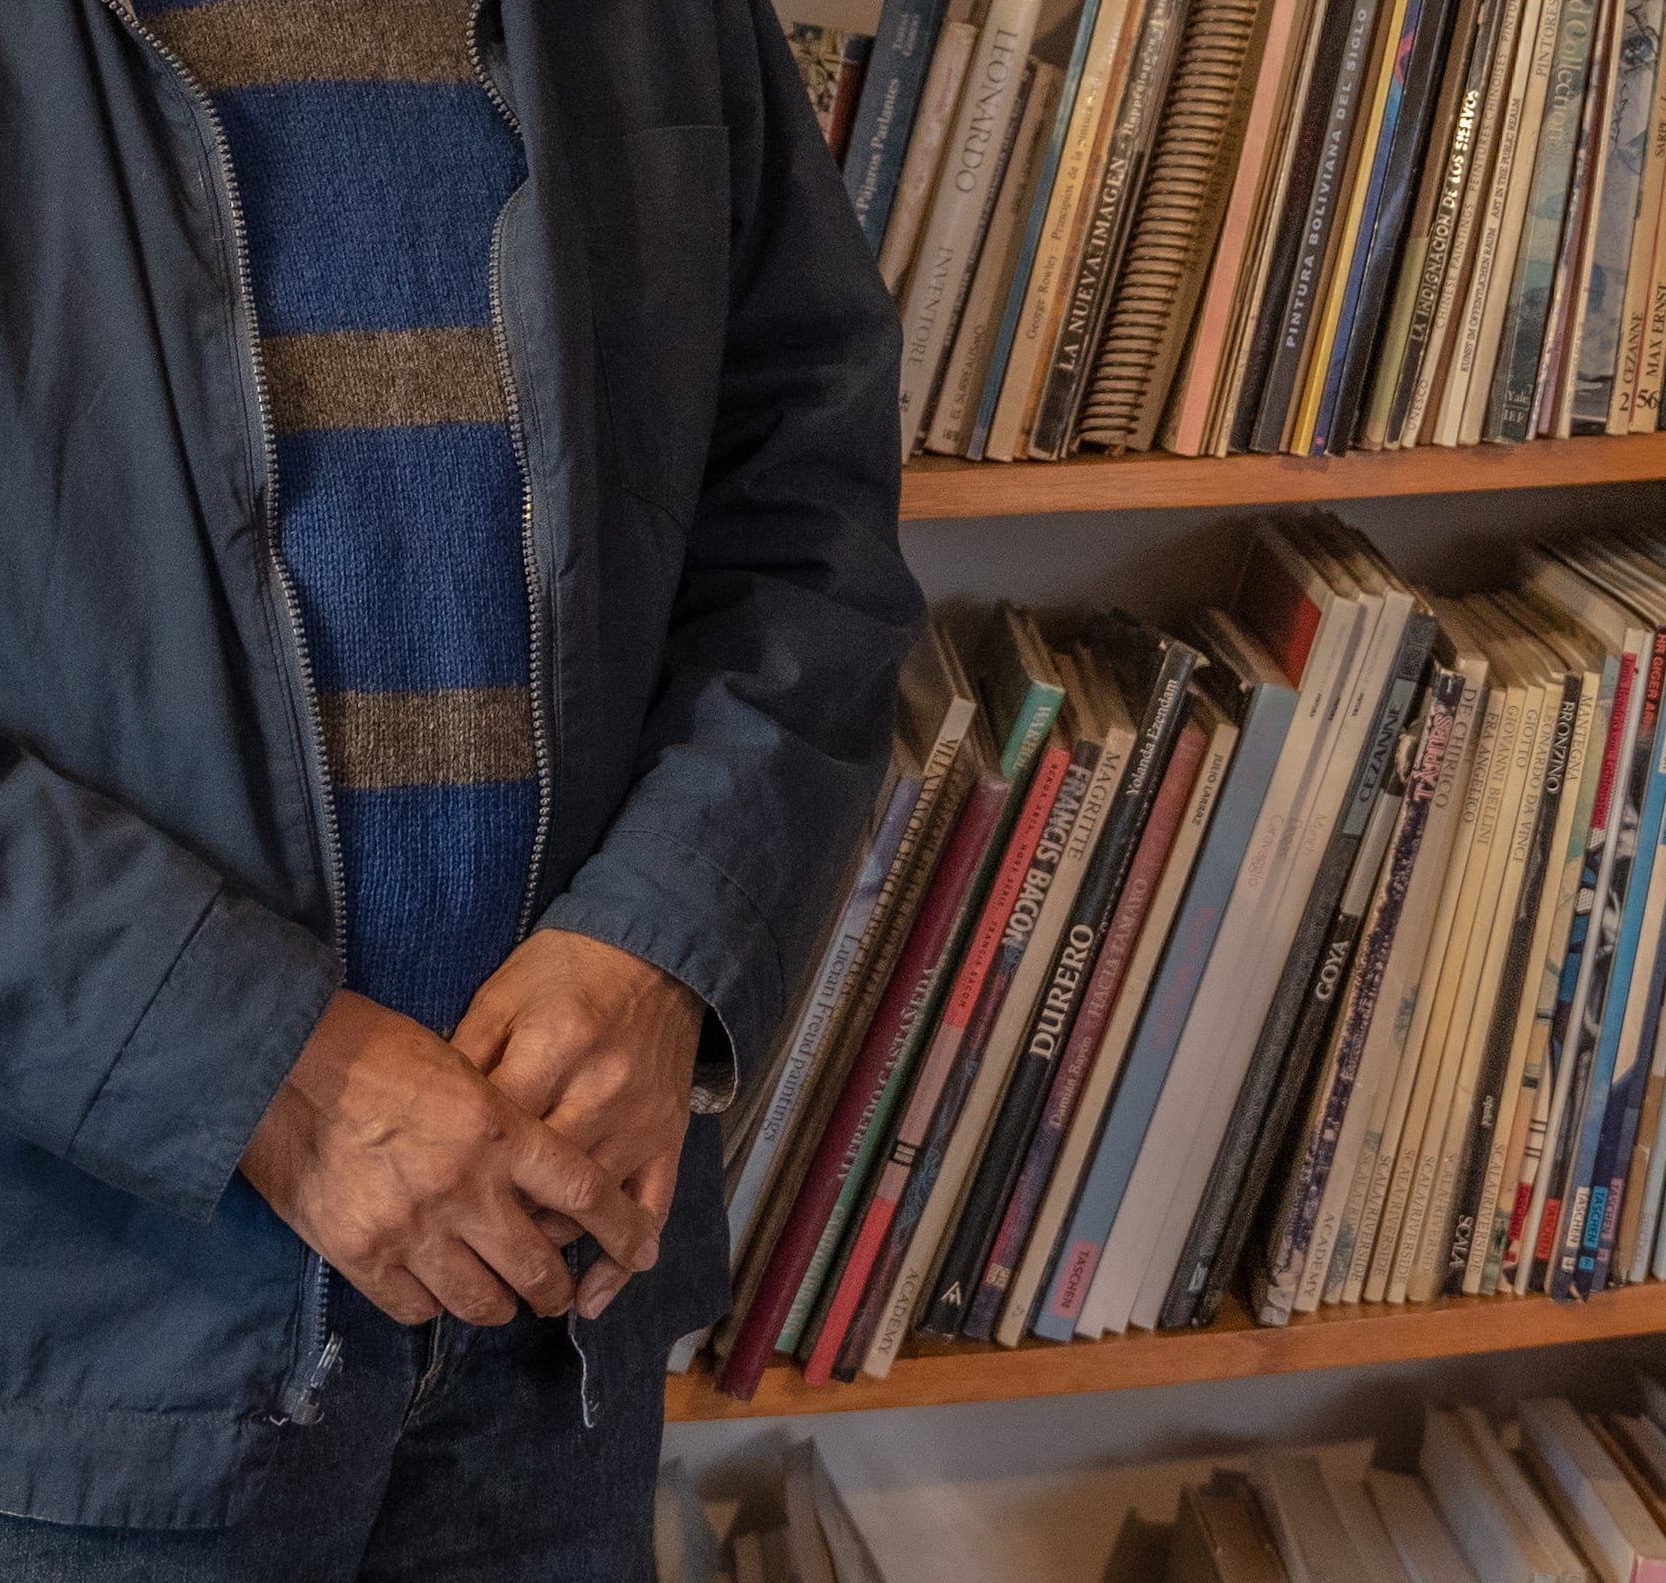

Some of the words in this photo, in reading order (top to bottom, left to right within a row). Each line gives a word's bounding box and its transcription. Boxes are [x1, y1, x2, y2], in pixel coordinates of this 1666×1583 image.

[952, 27, 1019, 194] LEONARDO
[1544, 17, 1589, 143] Collection
[1284, 253, 1316, 348] PINTURA
[1305, 129, 1344, 245] BOLIVIANA
[1334, 81, 1352, 118] DEL
[1344, 7, 1368, 71] SIGLO
[1615, 310, 1649, 384] CEZANNE
[1644, 338, 1664, 377] MAX
[1619, 391, 1631, 412] 2
[1456, 685, 1478, 715] DE
[1512, 707, 1540, 768] GIOTTO
[1563, 694, 1595, 782] MANTEGNA
[1205, 753, 1224, 783] JULIO
[1354, 701, 1406, 803] CEZANNE
[1432, 718, 1470, 808] CHIRICO
[1490, 703, 1519, 782] GIOVANNI
[1541, 699, 1577, 794] BRONZINO
[1030, 761, 1097, 864] FRANCIS
[1063, 749, 1124, 860] MAGRITTE
[1190, 784, 1213, 825] LARRAZ
[1476, 785, 1500, 844] BELLINI
[998, 865, 1053, 949] BACON
[818, 932, 861, 1000] Lucian
[1024, 922, 1100, 1061] DURERO
[1312, 937, 1351, 1002] GOYA
[796, 999, 834, 1056] Freud
[758, 1054, 811, 1142] paintings
[1060, 1247, 1090, 1308] TASCHEN
[1301, 1211, 1336, 1296] ACADEMY
[1448, 1213, 1473, 1268] SCALA
[877, 1266, 921, 1354] ACADEMY
